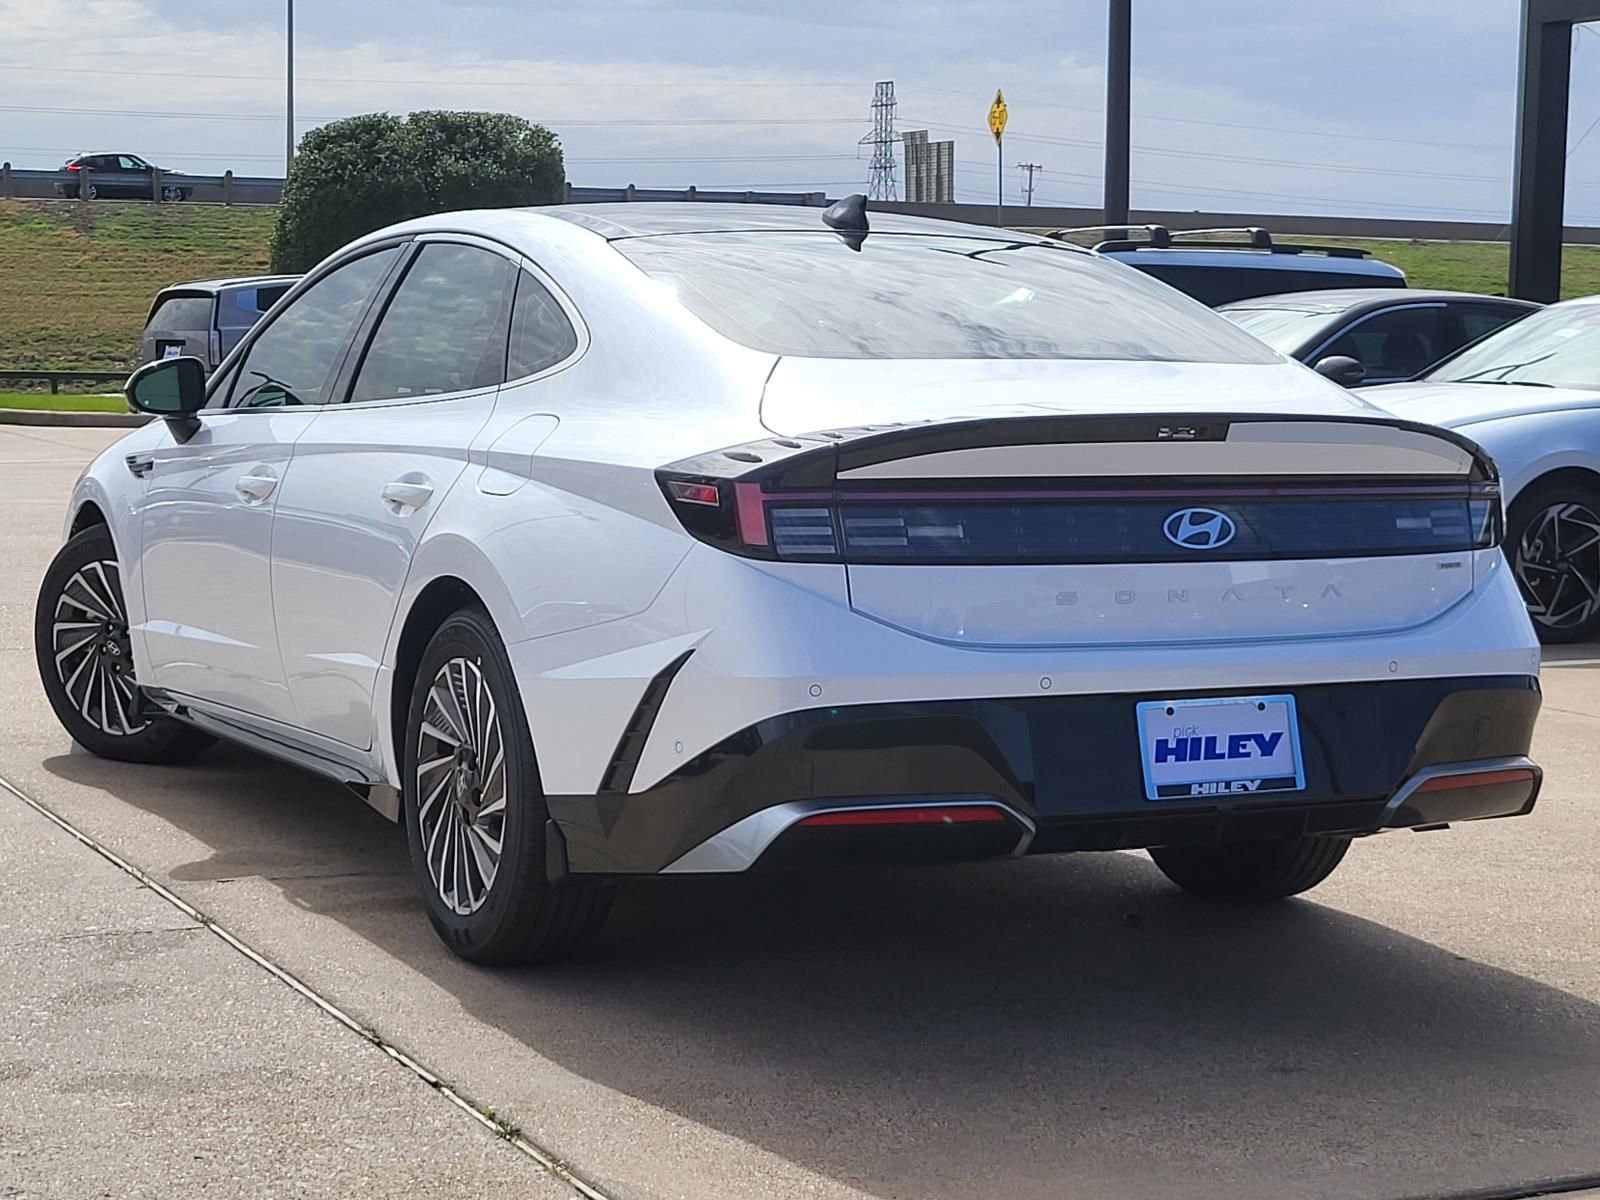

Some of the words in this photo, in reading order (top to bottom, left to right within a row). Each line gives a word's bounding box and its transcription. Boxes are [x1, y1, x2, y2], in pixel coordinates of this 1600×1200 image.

[1055, 583, 1343, 606] SONATA
[1154, 731, 1284, 763] HILEY
[1190, 779, 1262, 795] HILEY
